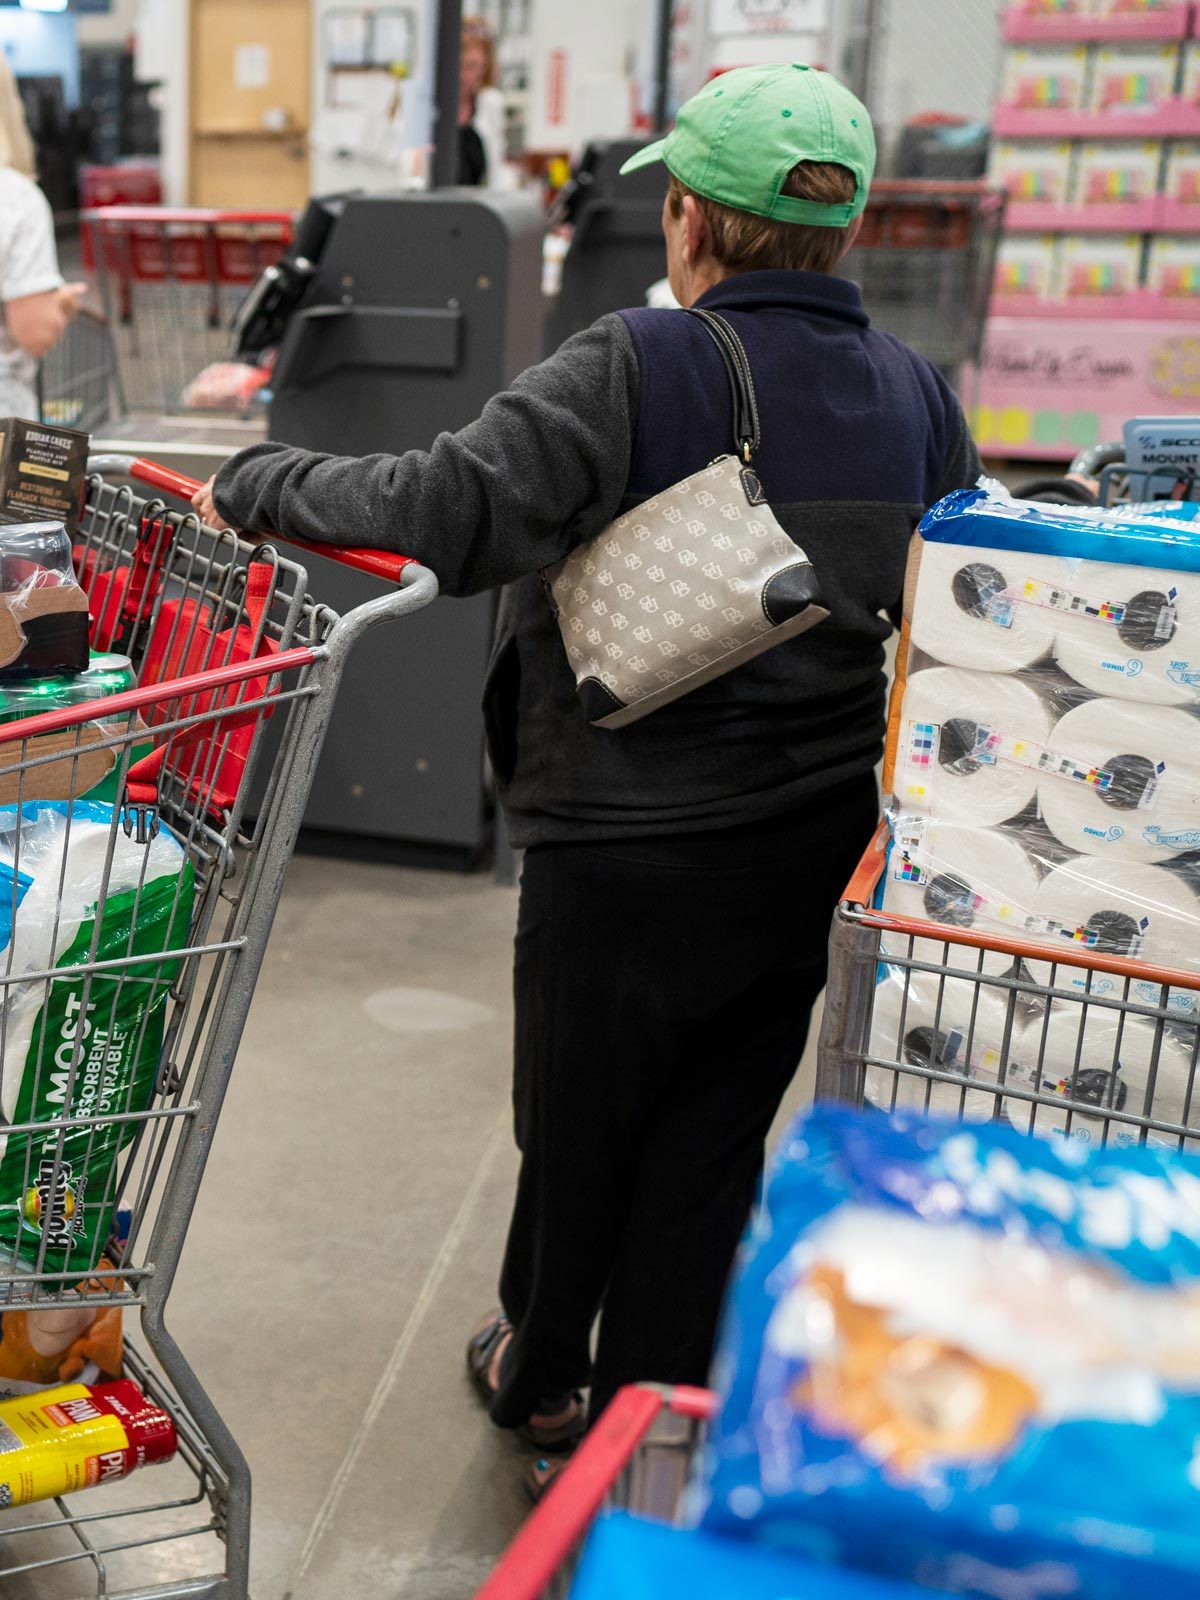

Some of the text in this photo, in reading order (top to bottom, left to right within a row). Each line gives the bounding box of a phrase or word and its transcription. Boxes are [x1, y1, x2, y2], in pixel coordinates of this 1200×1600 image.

[1142, 454, 1198, 464] MOUNT
[1072, 979, 1095, 991] JMBO
[46, 992, 97, 1104] MOST
[37, 1159, 78, 1250] Bounty
[59, 1397, 101, 1423] PAM
